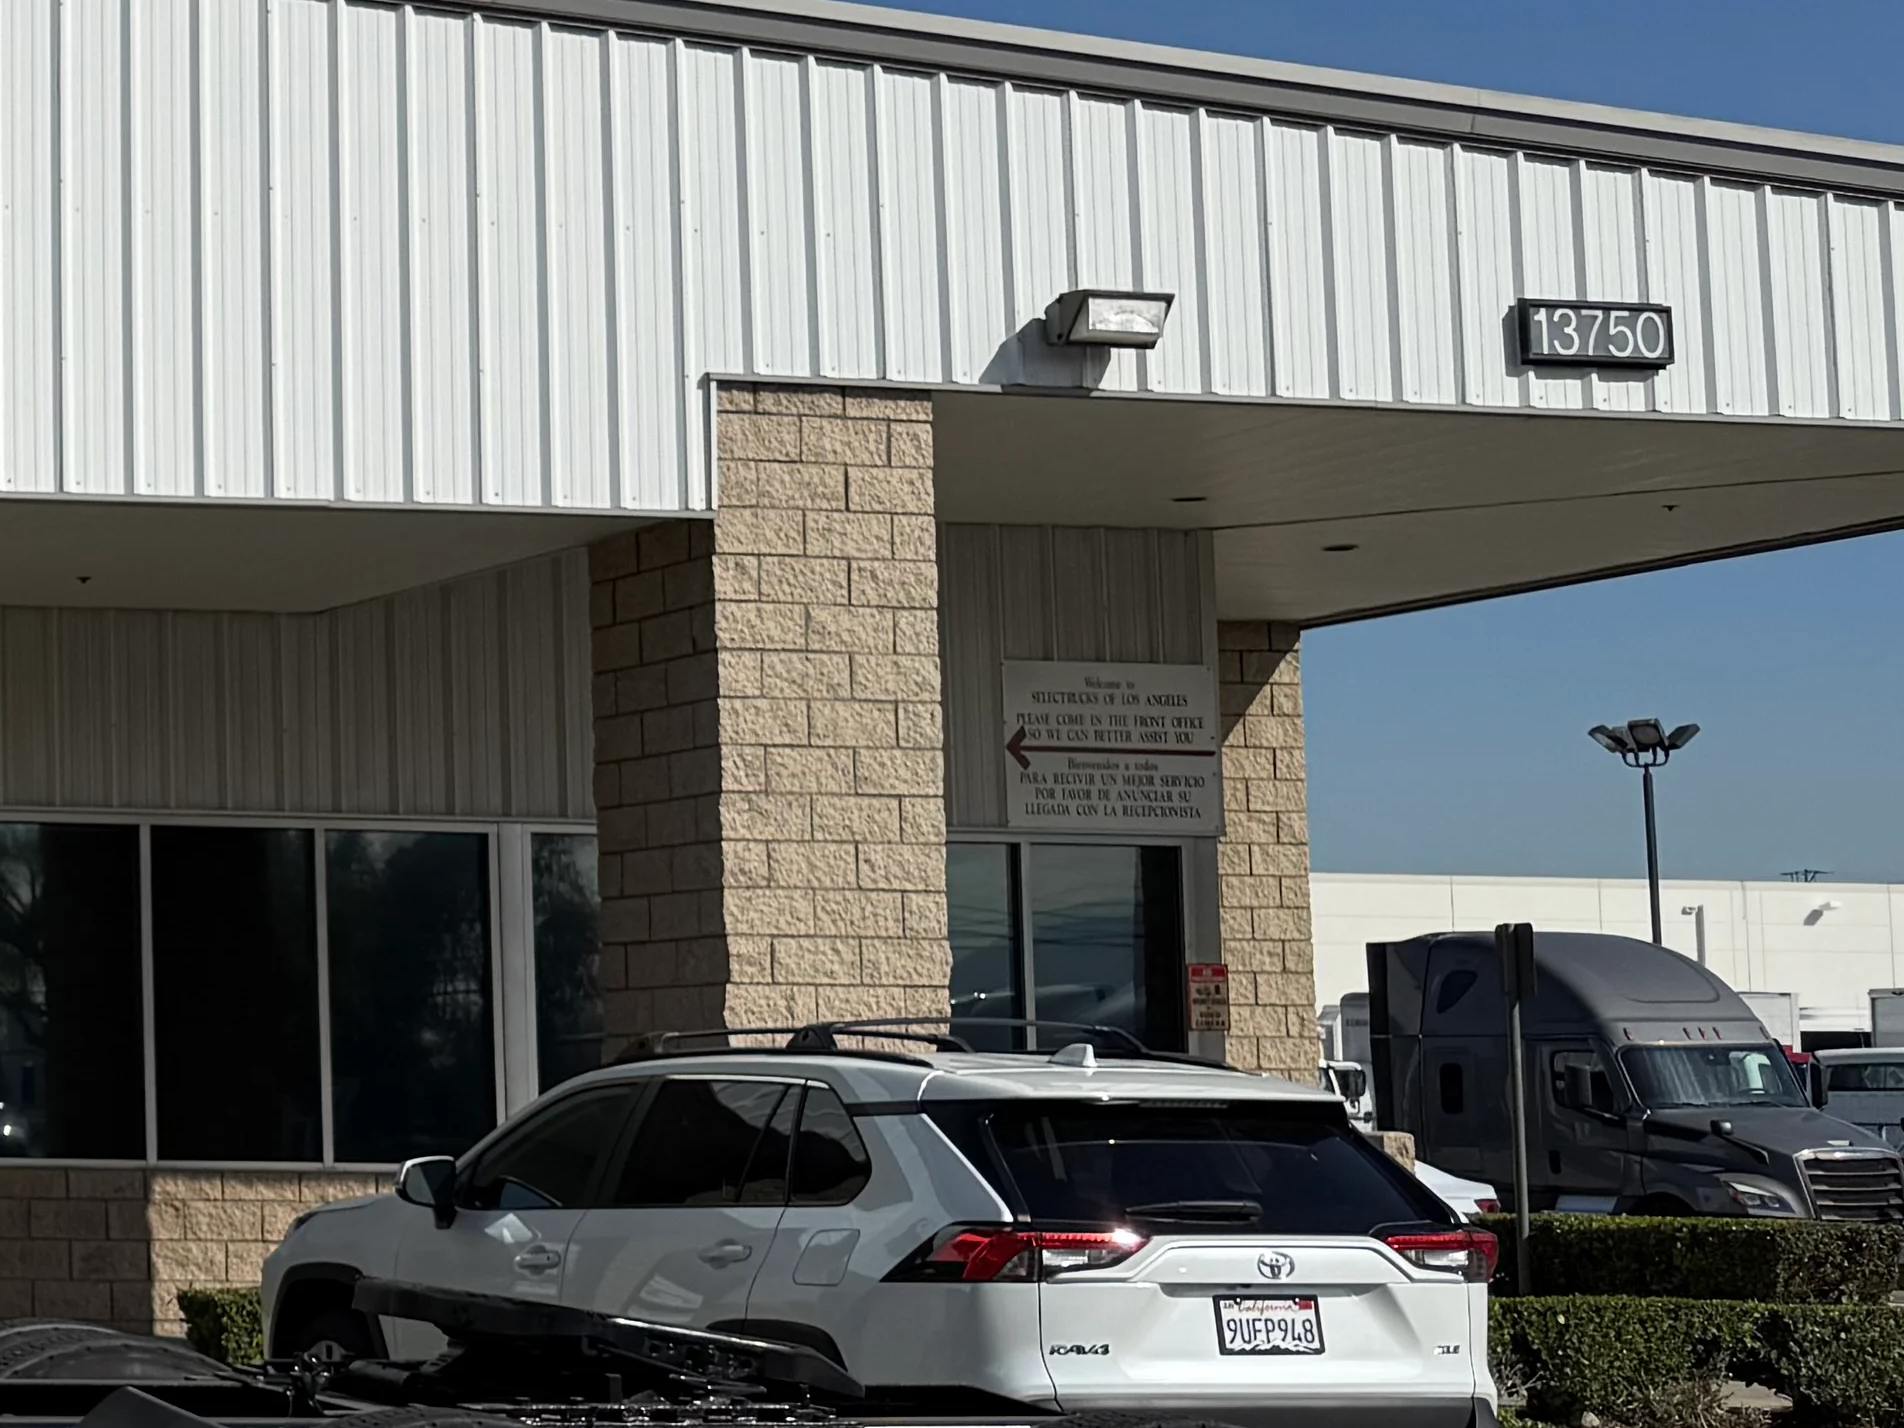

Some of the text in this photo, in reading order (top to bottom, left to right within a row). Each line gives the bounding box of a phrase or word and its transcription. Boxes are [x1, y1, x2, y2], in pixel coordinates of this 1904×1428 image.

[1533, 307, 1666, 359] 13750
[1032, 691, 1188, 707] SELECTRUCKS OF LOS ANGELES
[1016, 712, 1204, 729] PLEASE COME IN THE FRONT OFFICE
[1027, 728, 1193, 744] SO WE CAN BETTER ASSIST YOU
[1068, 757, 1119, 770] Bienvenidos
[1020, 772, 1205, 788] PARA RECIVIR UN MEJOR SERVICIO
[1035, 787, 1191, 803] POR FAVOR DE ANUNCIAR SU
[1025, 803, 1201, 819] LLEGADA CON LA RECEPCIONISTA
[1238, 1300, 1299, 1316] California
